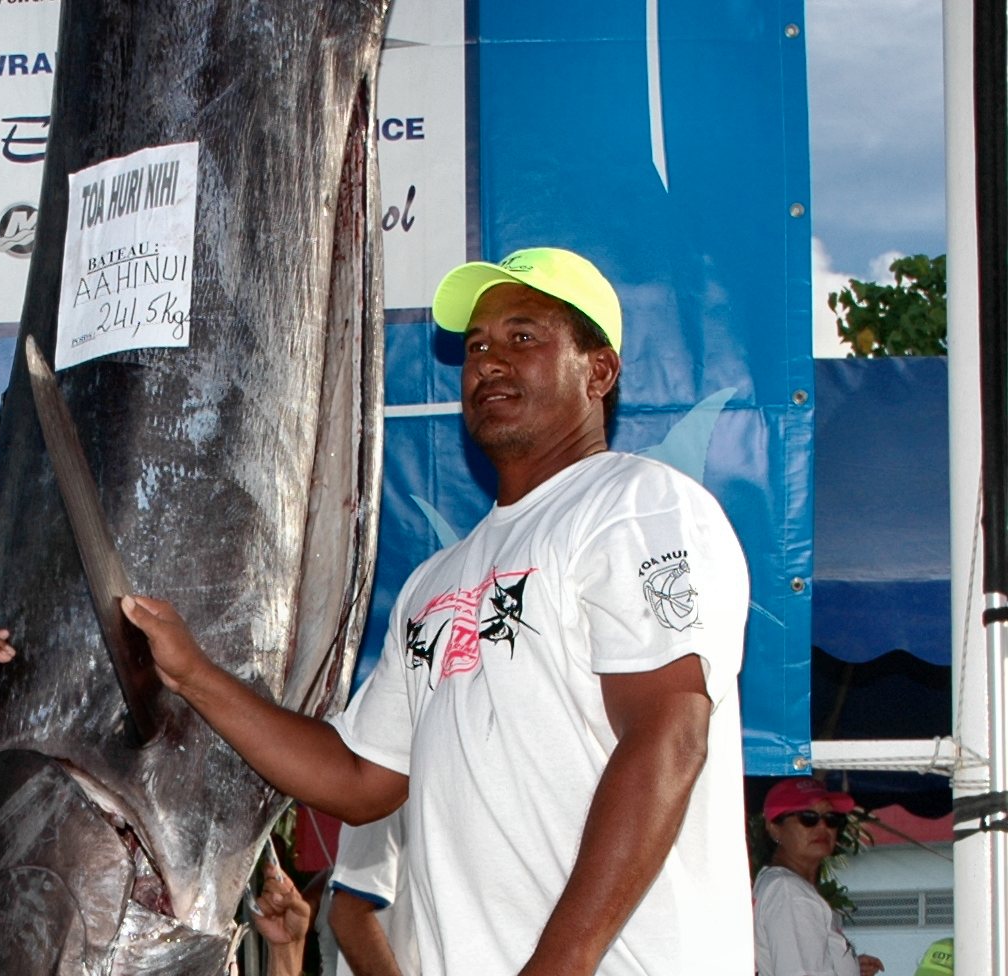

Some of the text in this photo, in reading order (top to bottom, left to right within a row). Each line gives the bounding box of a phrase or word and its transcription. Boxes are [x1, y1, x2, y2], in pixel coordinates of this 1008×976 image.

[80, 179, 106, 231] TOA
[107, 167, 144, 221] HURI
[638, 558, 660, 578] TOA
